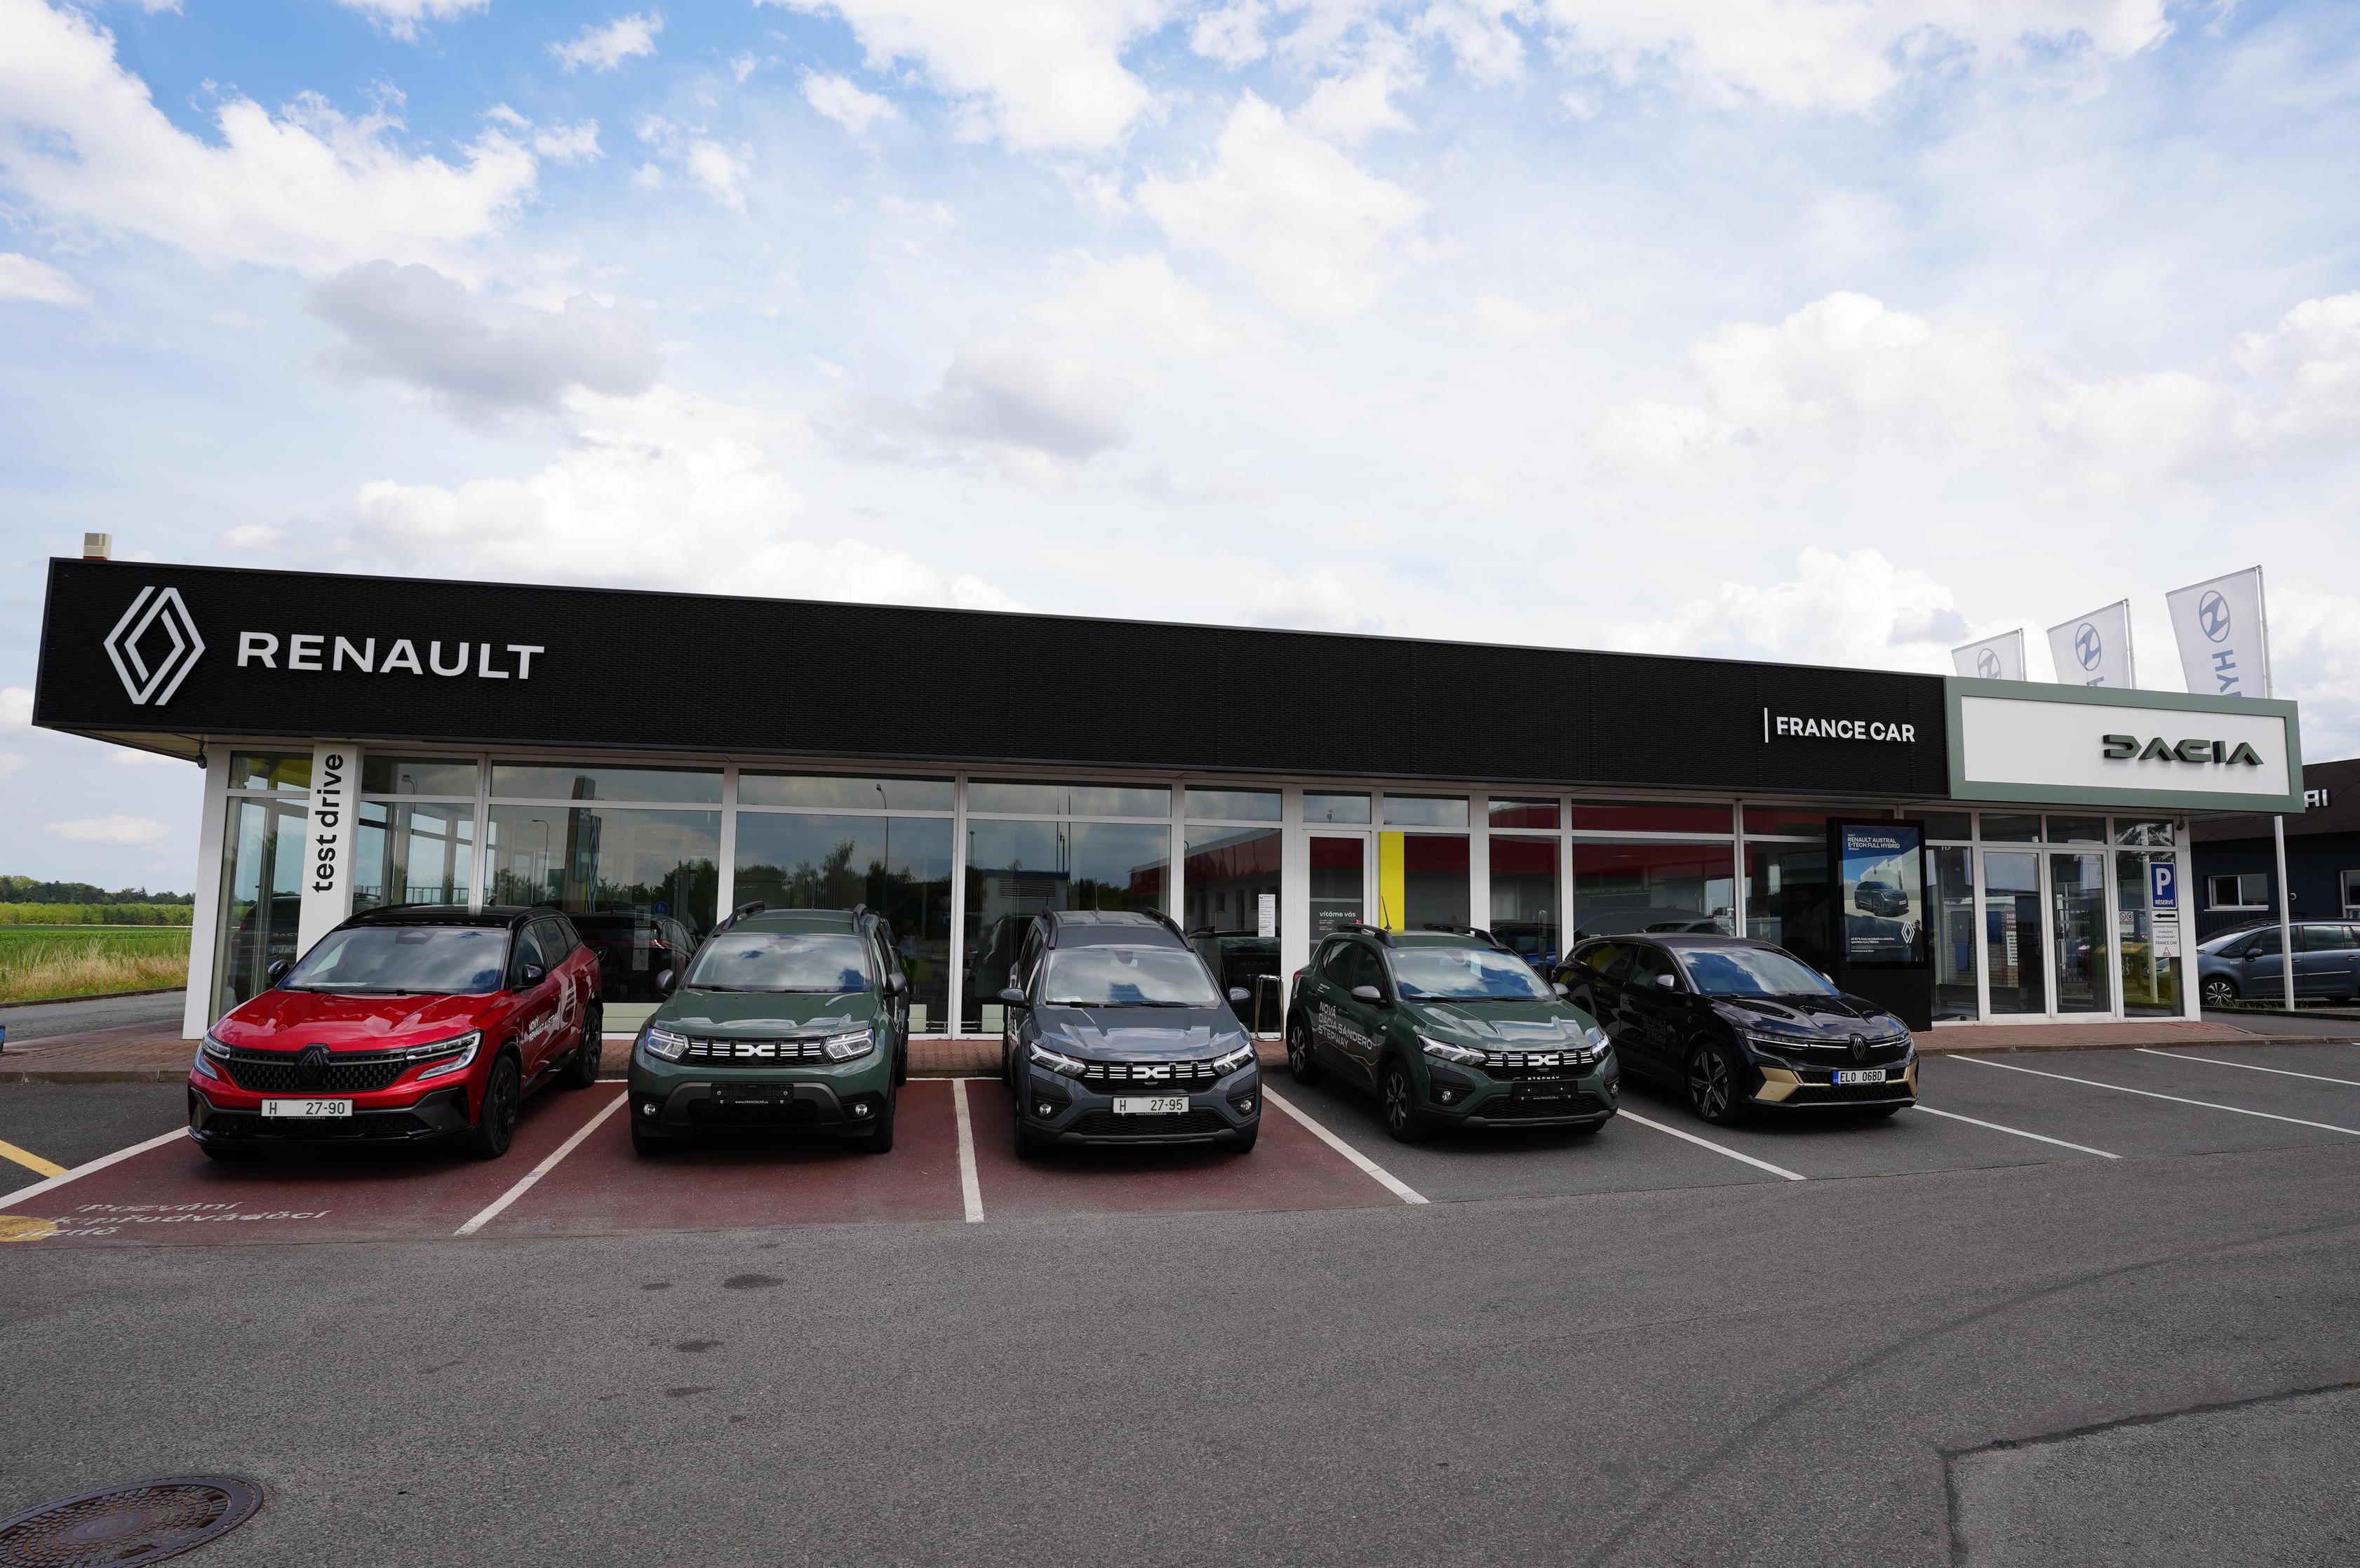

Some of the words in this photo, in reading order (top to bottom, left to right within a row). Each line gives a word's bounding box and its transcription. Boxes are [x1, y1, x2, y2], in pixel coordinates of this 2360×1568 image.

[237, 631, 545, 680] RENAULT
[1776, 716, 1866, 739] FRANCE
[1870, 722, 1916, 742] CAR
[2103, 735, 2265, 765] DACIA
[315, 754, 344, 828] drive
[311, 835, 337, 894] test
[2155, 868, 2171, 895] P
[1320, 1001, 1336, 1019] NOVÁ
[1318, 1012, 1337, 1031] DACIA
[1338, 1024, 1372, 1050] SANDERO
[1318, 1024, 1348, 1049] STEPWAY
[269, 1102, 277, 1115] H
[306, 1102, 345, 1115] 27-90
[1120, 1099, 1127, 1112] H
[1151, 1099, 1184, 1111] 27-95
